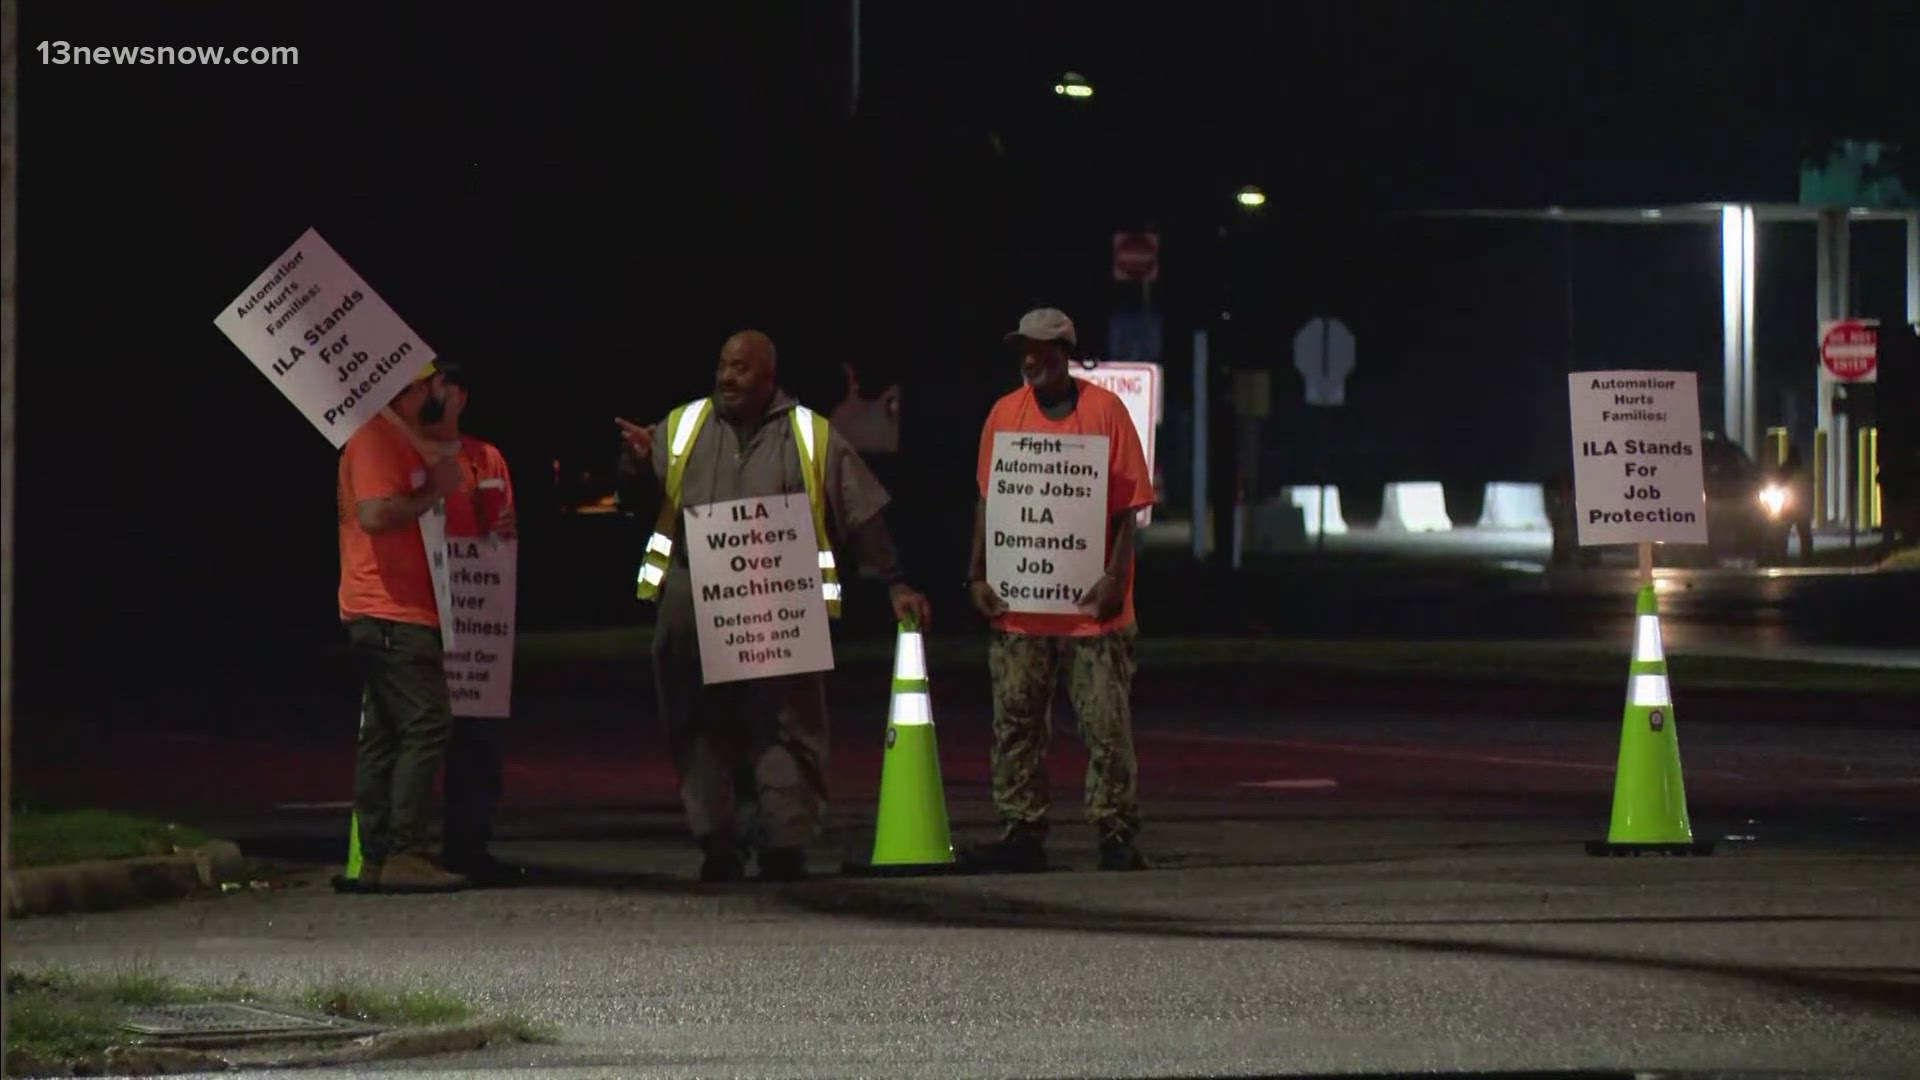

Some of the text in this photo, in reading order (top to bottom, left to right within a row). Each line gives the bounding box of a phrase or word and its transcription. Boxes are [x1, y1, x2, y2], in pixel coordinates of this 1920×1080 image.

[236, 250, 305, 320] Automation
[263, 281, 300, 314] Hurts
[265, 283, 321, 336] Families:
[271, 289, 365, 377] ILA Stands
[318, 332, 351, 365] For
[336, 350, 369, 383] Job
[323, 341, 413, 427] Protection
[1591, 378, 1676, 390] Automation
[1614, 394, 1654, 405] Hurts
[1019, 437, 1063, 453] Fight
[1583, 439, 1693, 456] ILA Stands
[994, 459, 1099, 479] Automation,
[1625, 463, 1658, 477] For
[997, 480, 1092, 498] Save Jobs:
[1624, 485, 1661, 500] Job
[731, 503, 769, 522] ILA
[1020, 507, 1054, 524] ILA
[1589, 507, 1696, 524] Protection
[707, 527, 798, 550] Workers
[994, 531, 1087, 550] Demands
[730, 555, 782, 573] Over
[1016, 558, 1054, 574] Job
[450, 568, 501, 585] rkers
[702, 576, 815, 602] Machines:
[1000, 581, 1084, 604] Security
[451, 594, 486, 610] ver
[713, 607, 806, 628] Defend Our
[453, 618, 509, 636] hines:
[725, 627, 800, 646] Jobs and
[738, 647, 792, 664] Rights
